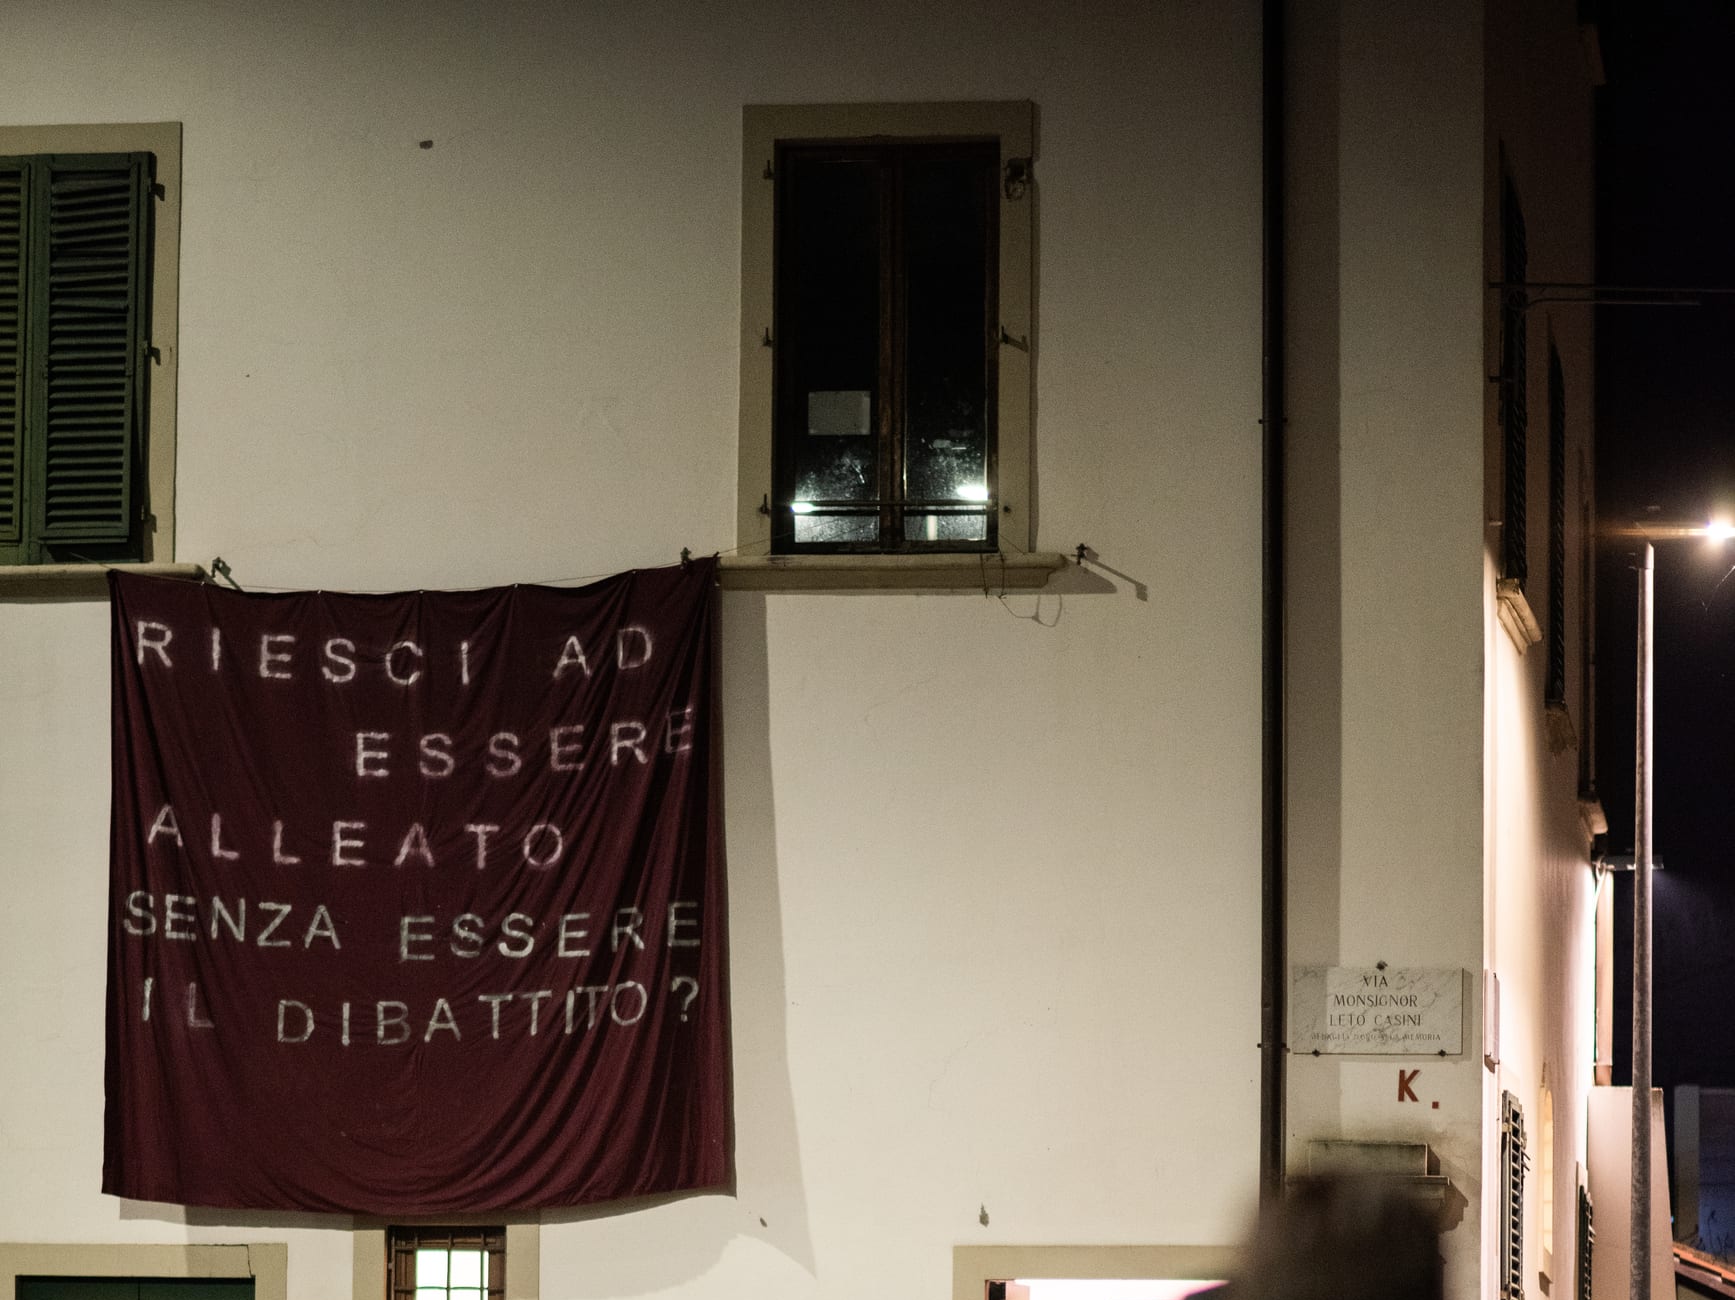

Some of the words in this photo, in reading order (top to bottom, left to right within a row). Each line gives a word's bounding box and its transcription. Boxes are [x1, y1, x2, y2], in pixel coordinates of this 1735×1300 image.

[136, 621, 472, 685] RIESCI
[553, 626, 652, 681] AD
[355, 706, 694, 778] ESSERE
[147, 804, 564, 870] ALLEATO
[123, 891, 341, 949] SENZA
[400, 902, 701, 961] ESSERE
[141, 977, 214, 1029] IL
[1333, 994, 1418, 1008] MONSIGNOR
[1363, 975, 1388, 988] VIA
[1329, 1014, 1366, 1026] LETO
[1374, 1014, 1423, 1027] CASINI
